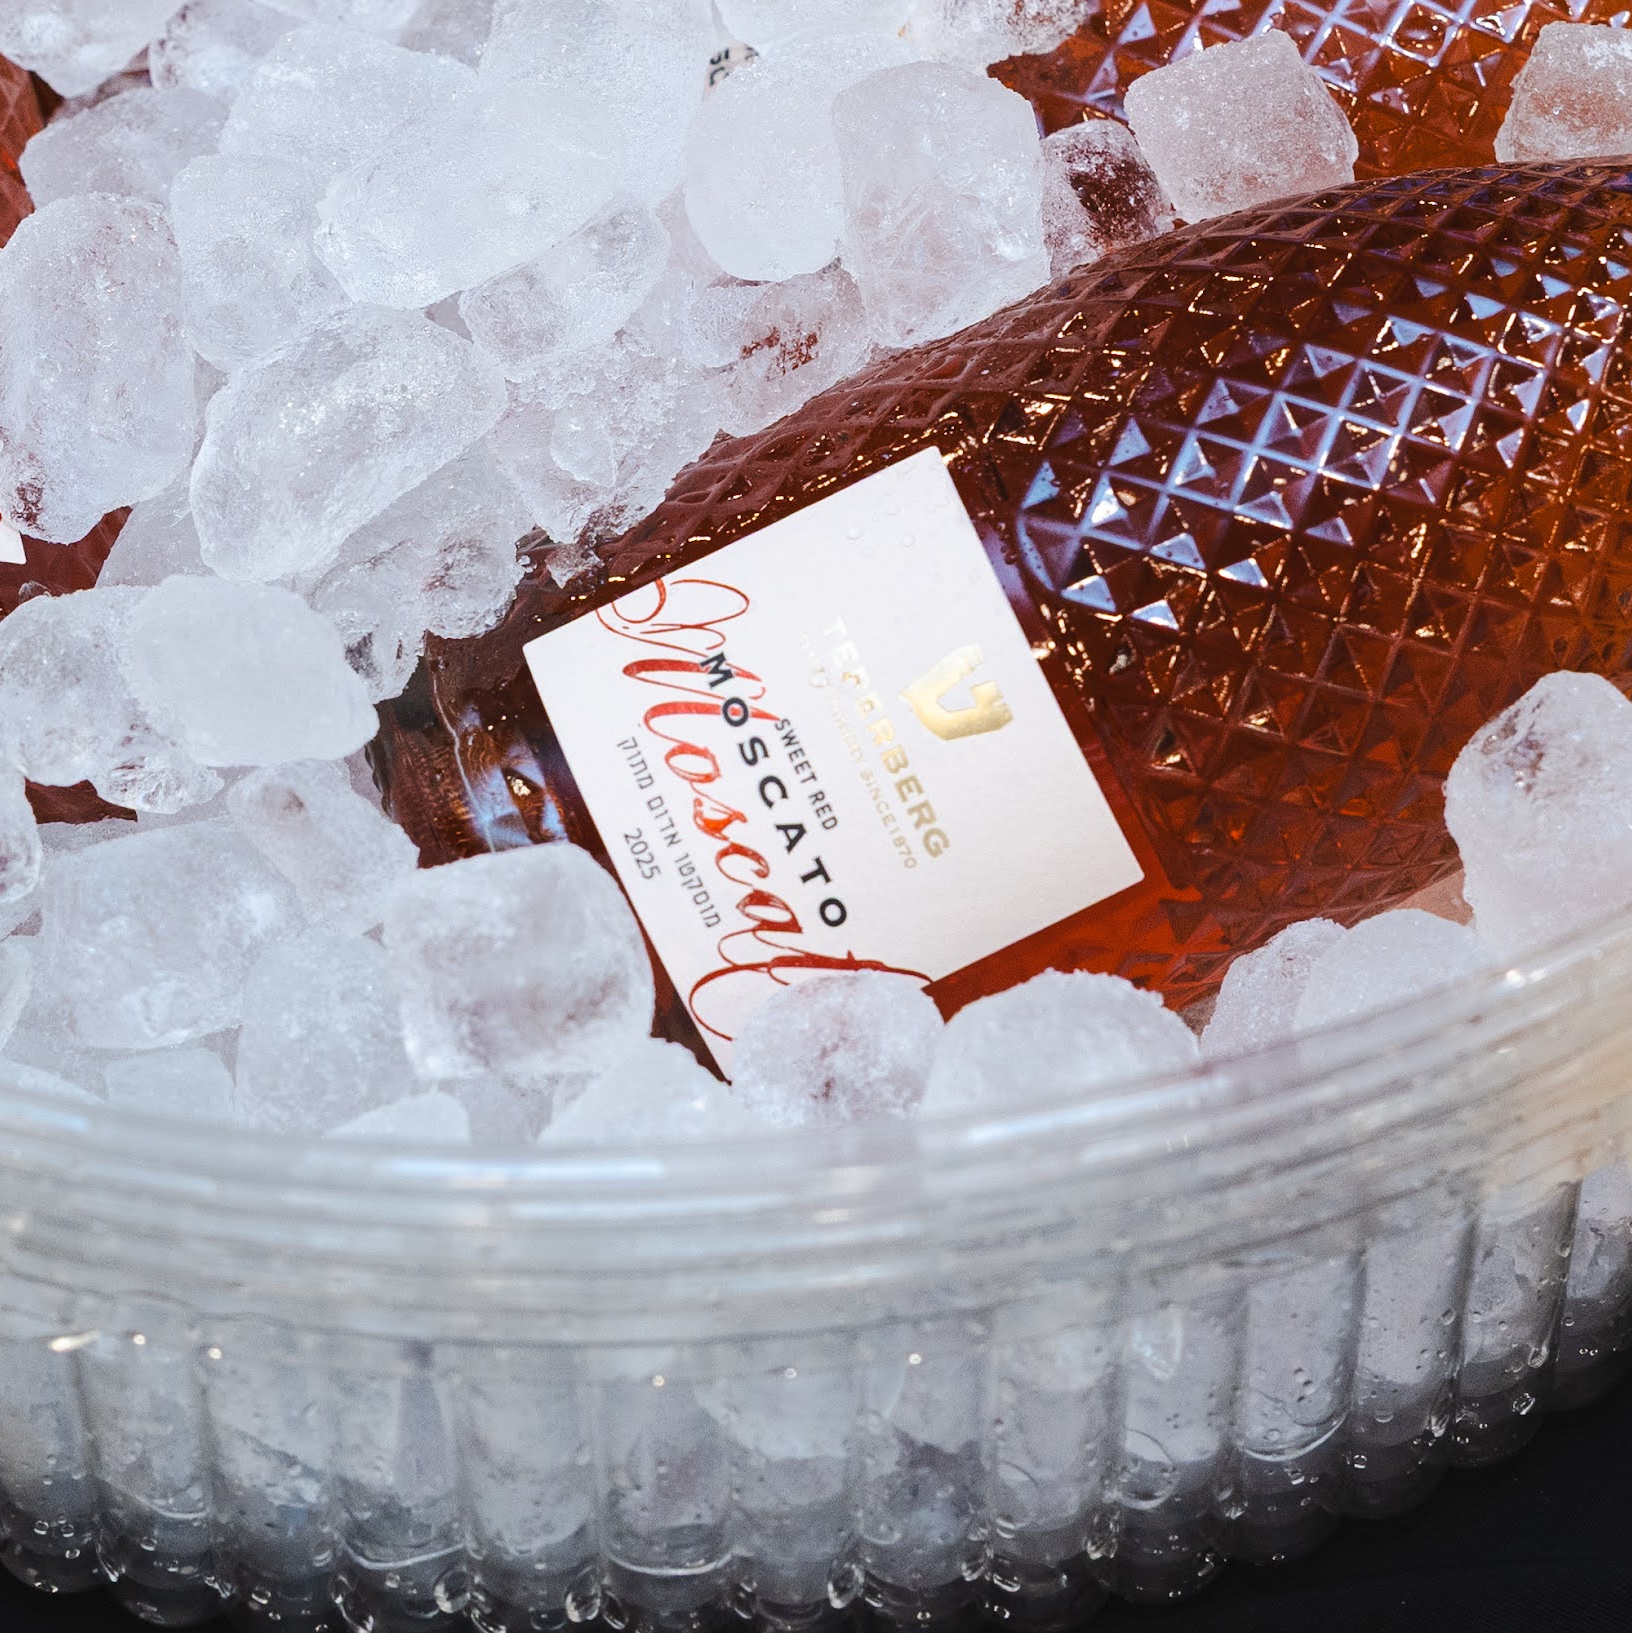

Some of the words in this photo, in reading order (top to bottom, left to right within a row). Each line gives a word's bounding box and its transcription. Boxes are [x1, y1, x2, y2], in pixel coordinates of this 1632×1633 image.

[616, 736, 655, 790] מתוק
[699, 652, 848, 927] MOSCATO
[774, 717, 817, 786] SWEET
[808, 790, 839, 831] RED
[596, 578, 934, 1042] Moscat
[647, 795, 682, 848] אדום
[624, 827, 662, 881] 2025
[675, 852, 722, 929] מוסקטו
